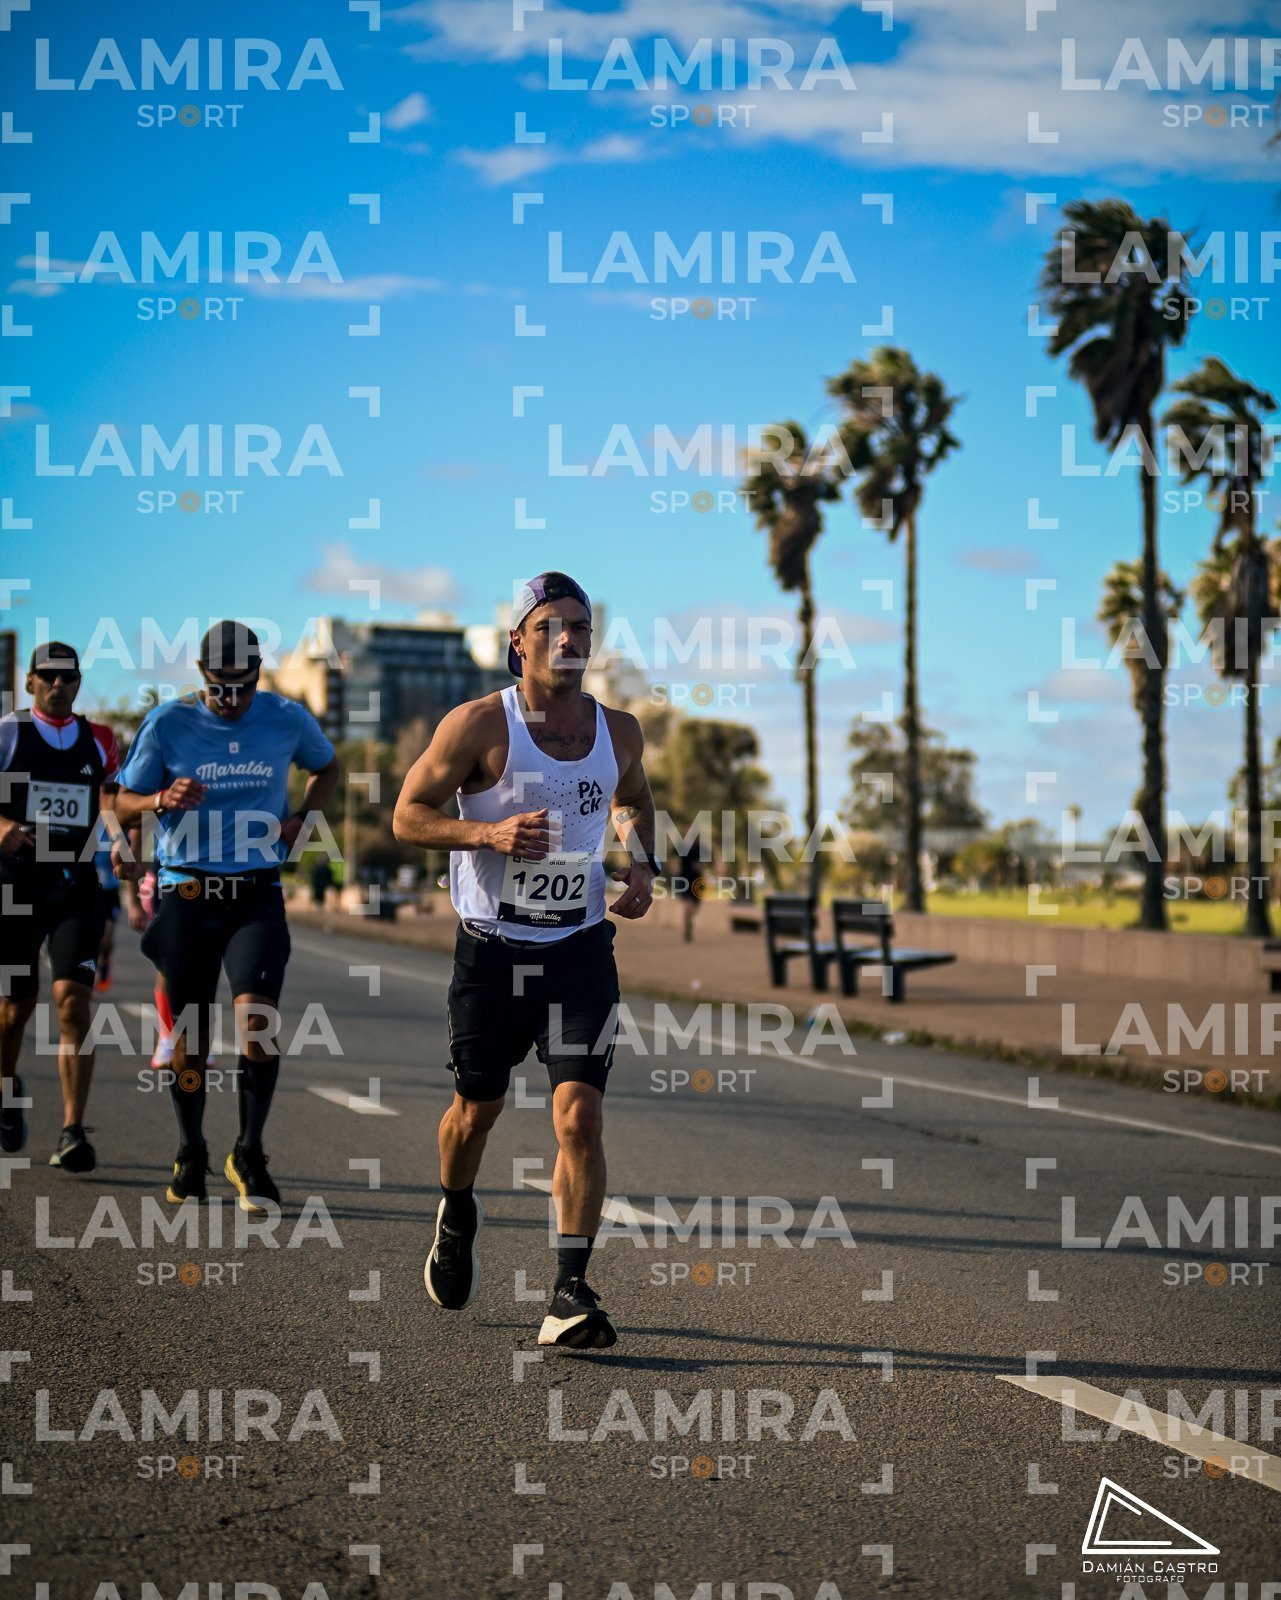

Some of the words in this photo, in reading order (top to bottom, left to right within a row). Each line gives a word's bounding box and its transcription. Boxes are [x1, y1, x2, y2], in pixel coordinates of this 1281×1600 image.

[195, 760, 273, 780] Maratón
[39, 797, 78, 819] 230
[512, 870, 585, 901] 1202
